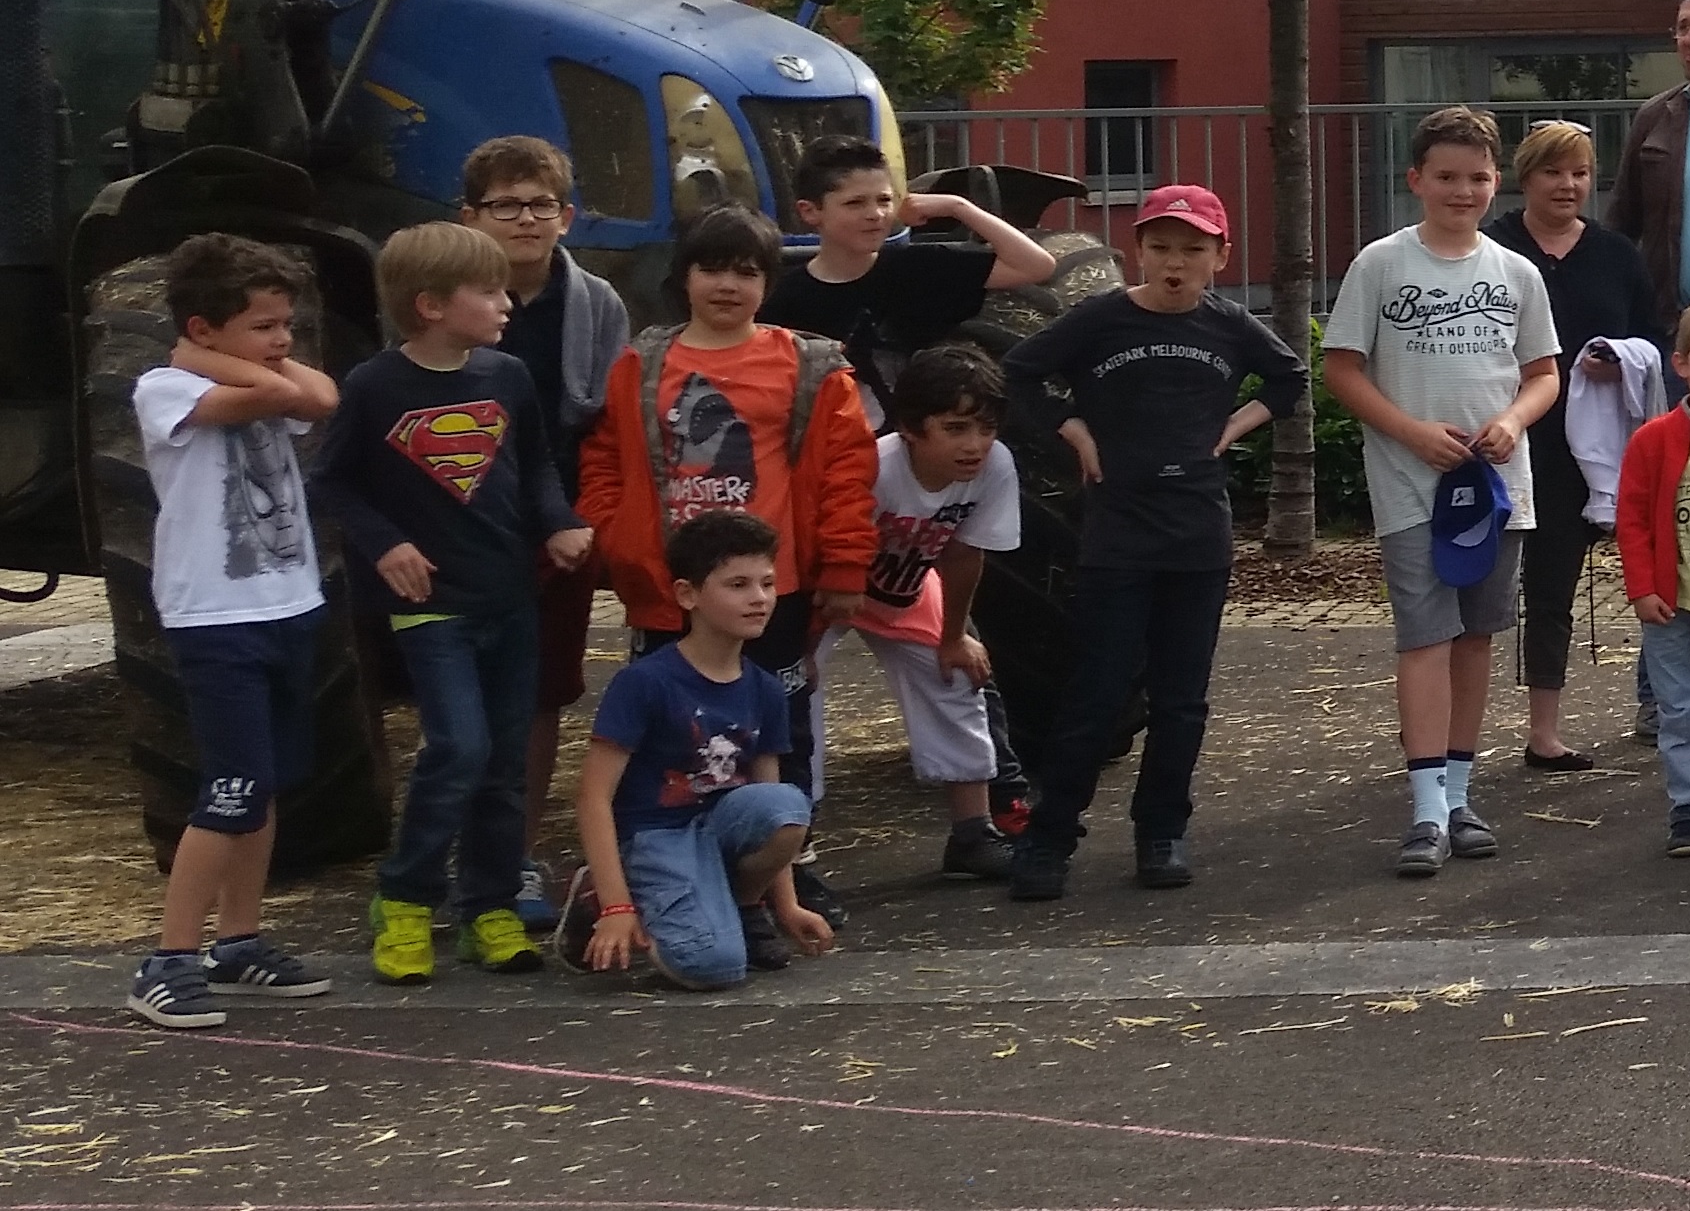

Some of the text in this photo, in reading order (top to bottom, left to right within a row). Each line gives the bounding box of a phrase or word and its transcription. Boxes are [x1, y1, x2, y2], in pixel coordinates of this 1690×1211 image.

[1382, 284, 1464, 330] Beyond
[1426, 325, 1489, 338] LAND OF
[1406, 338, 1508, 355] GREAT OUTDOORS
[1092, 345, 1148, 379] SKATEPARK
[1150, 343, 1213, 364] MELBOURNE
